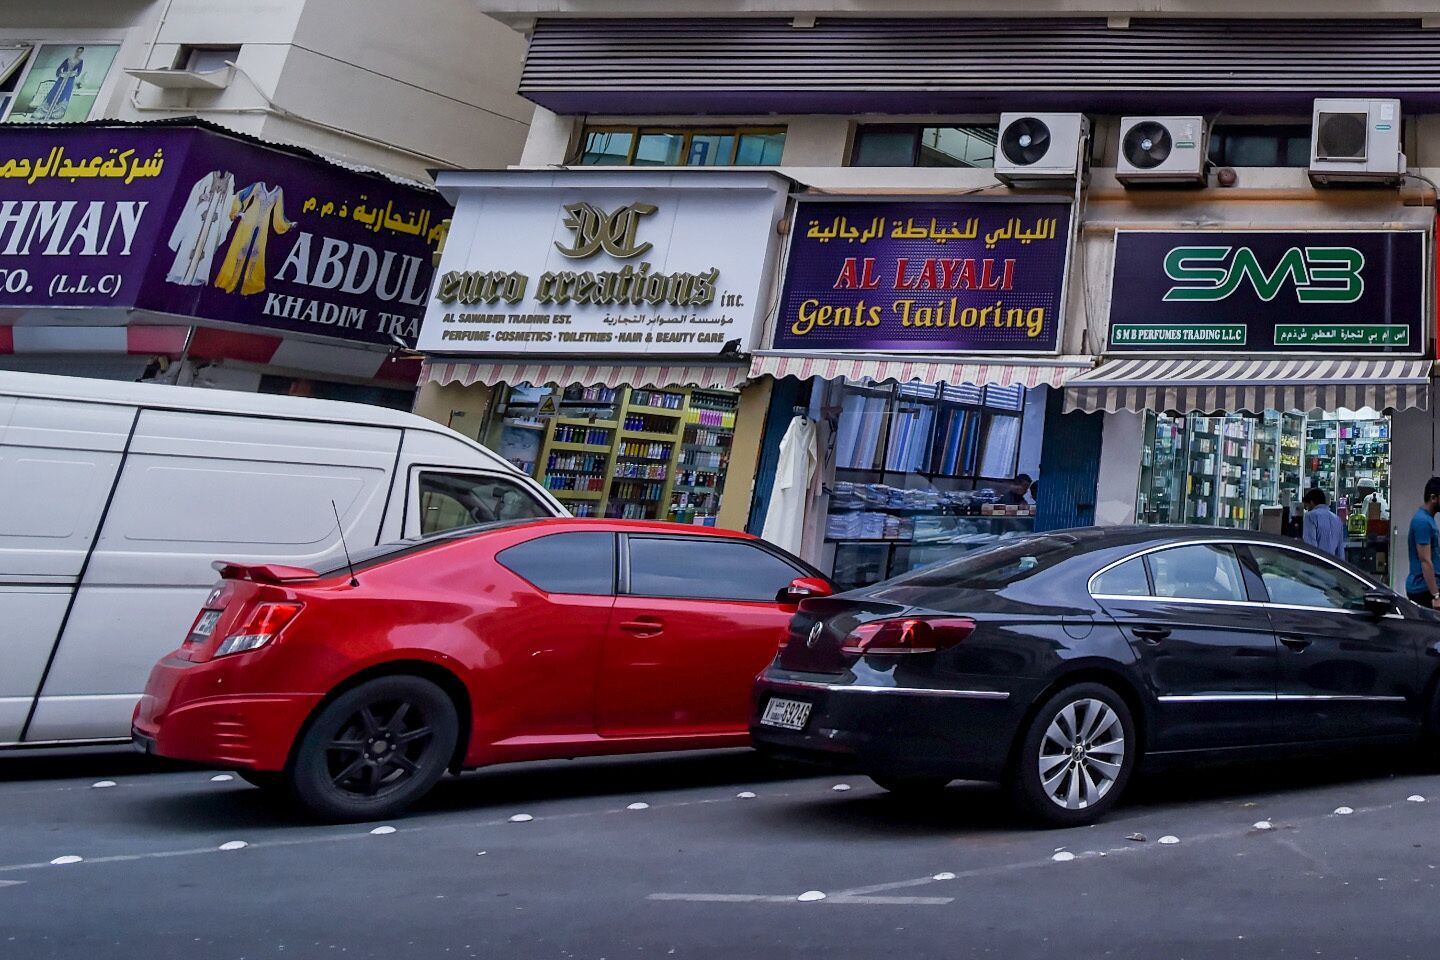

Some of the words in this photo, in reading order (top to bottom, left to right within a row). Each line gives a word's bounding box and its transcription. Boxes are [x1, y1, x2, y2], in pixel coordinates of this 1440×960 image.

[100, 148, 164, 184] شركة
[353, 194, 431, 237] التجارية
[807, 216, 886, 244] الرجالية
[890, 217, 980, 245] للخياطة
[985, 217, 1058, 249] الليالي
[49, 274, 122, 298] (L.L.C)
[435, 270, 529, 305] euro
[533, 261, 720, 306] creations
[833, 257, 882, 290] AL
[893, 257, 1017, 291] LAYALI
[262, 292, 369, 330] KHADIM
[443, 313, 455, 323] AL
[508, 314, 550, 324] TRADING
[552, 315, 572, 325] EST.
[791, 298, 883, 337] Gents
[892, 296, 1047, 338] Tailoring
[442, 330, 491, 341] PERFUME
[495, 331, 552, 342] COSMETICS
[558, 331, 613, 342] TOILETRIES
[619, 332, 643, 343] HAIR
[656, 332, 696, 343] BEAUTY
[697, 332, 725, 343] CARE
[1115, 329, 1122, 340] S
[1122, 329, 1131, 340] M
[1131, 329, 1137, 340] B
[1138, 329, 1182, 340] PERFUMES
[1182, 329, 1221, 340] TRADING
[1221, 329, 1242, 340] L.L.C
